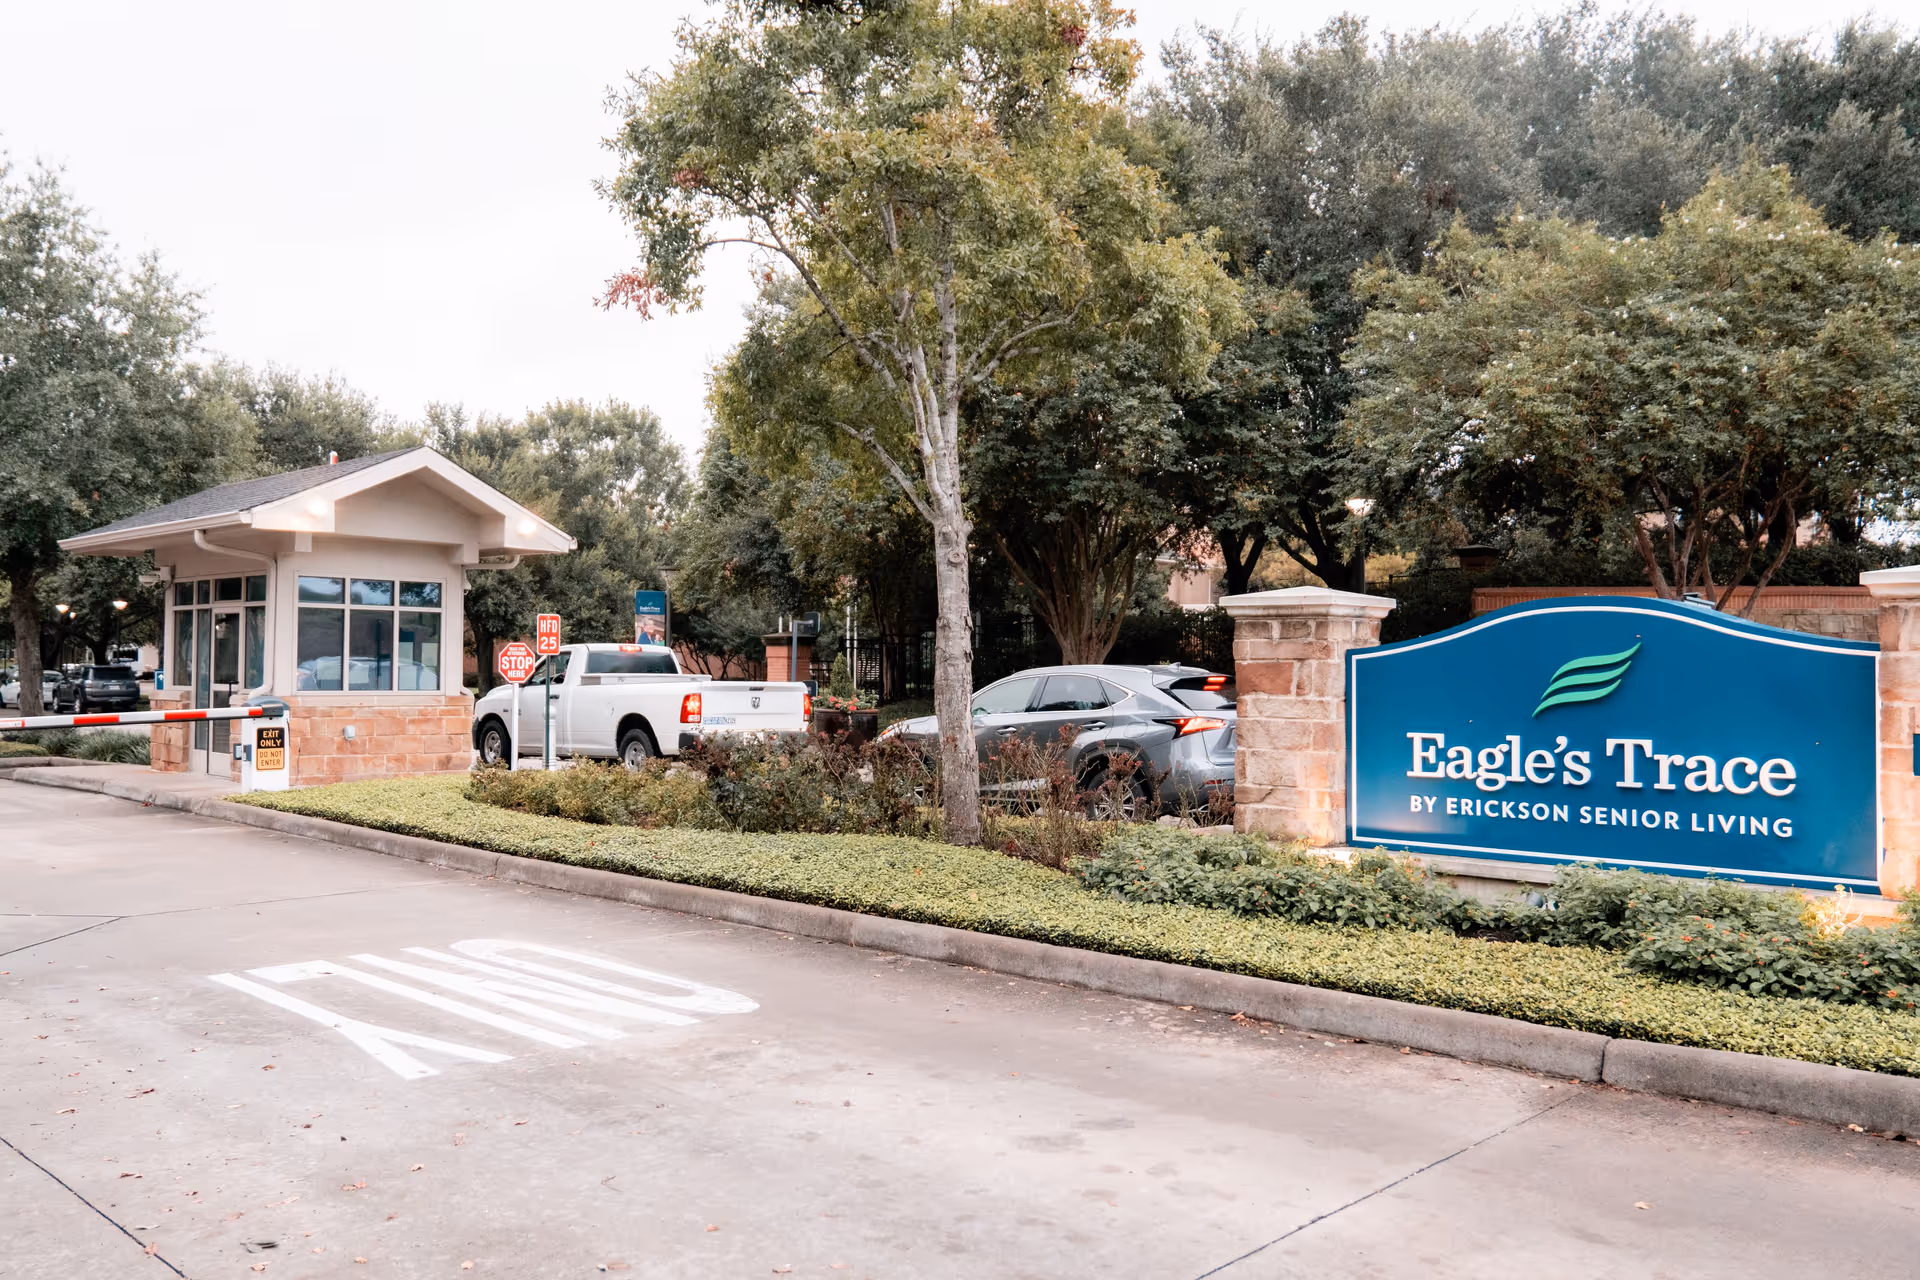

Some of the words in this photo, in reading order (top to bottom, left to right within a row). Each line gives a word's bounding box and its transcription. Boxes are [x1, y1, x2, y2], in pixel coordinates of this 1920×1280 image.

[540, 619, 558, 633] HFD
[540, 637, 557, 650] 25
[501, 656, 533, 670] STOP
[507, 670, 526, 678] HERE
[262, 730, 280, 738] EXIT
[260, 739, 282, 747] ONLY
[270, 750, 282, 758] NOT
[1406, 732, 1592, 792] Eagle's
[1605, 738, 1797, 796] Trace
[1410, 795, 1437, 813] BY
[1446, 797, 1569, 823] ERICKSON
[1579, 805, 1680, 830] SENIOR
[1690, 812, 1793, 838] LIVING
[207, 938, 761, 1081] ONLY
